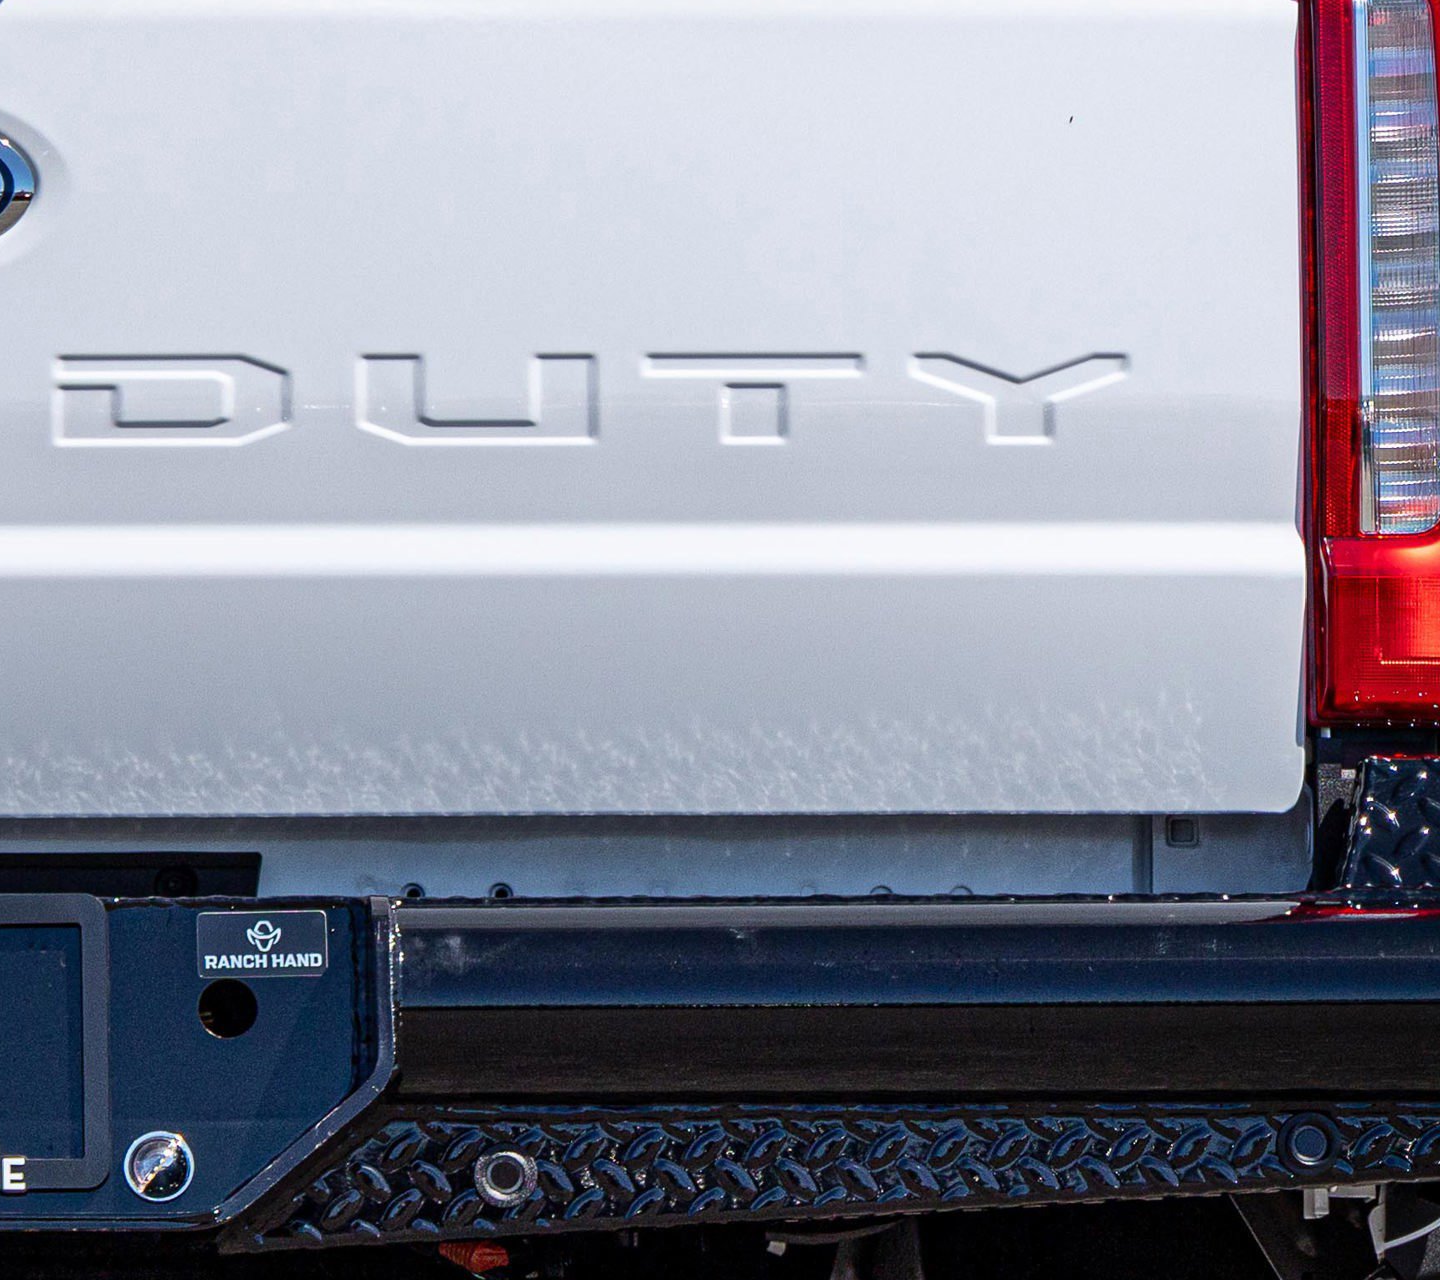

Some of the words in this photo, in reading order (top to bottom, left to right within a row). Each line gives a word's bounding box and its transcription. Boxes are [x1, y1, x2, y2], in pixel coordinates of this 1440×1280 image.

[52, 351, 1131, 449] DUTY
[204, 954, 268, 969] RANCH
[271, 952, 323, 968] HAND
